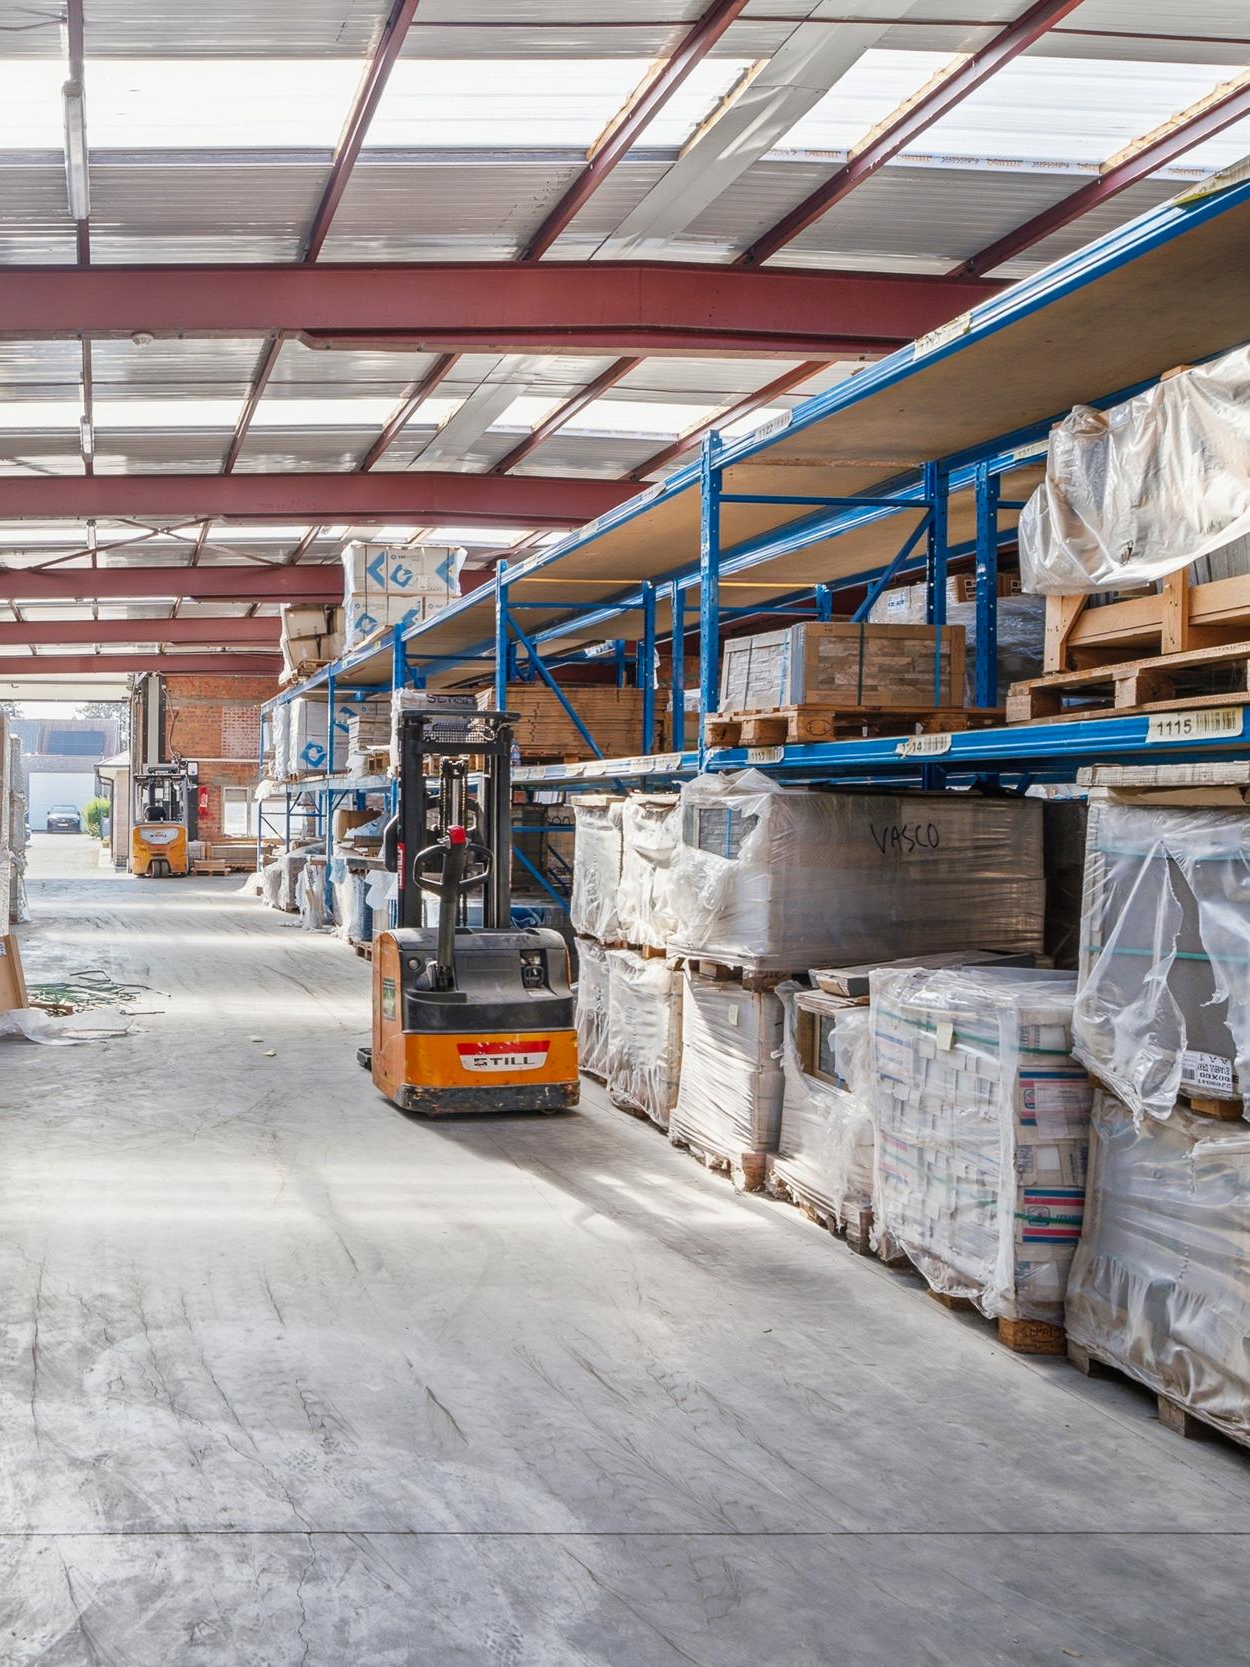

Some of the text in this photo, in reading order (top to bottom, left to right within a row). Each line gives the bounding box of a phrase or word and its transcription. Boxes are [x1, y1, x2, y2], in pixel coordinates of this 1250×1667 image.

[1157, 719, 1192, 736] 1115
[870, 823, 940, 855] VASCO
[473, 1056, 535, 1067] STILL
